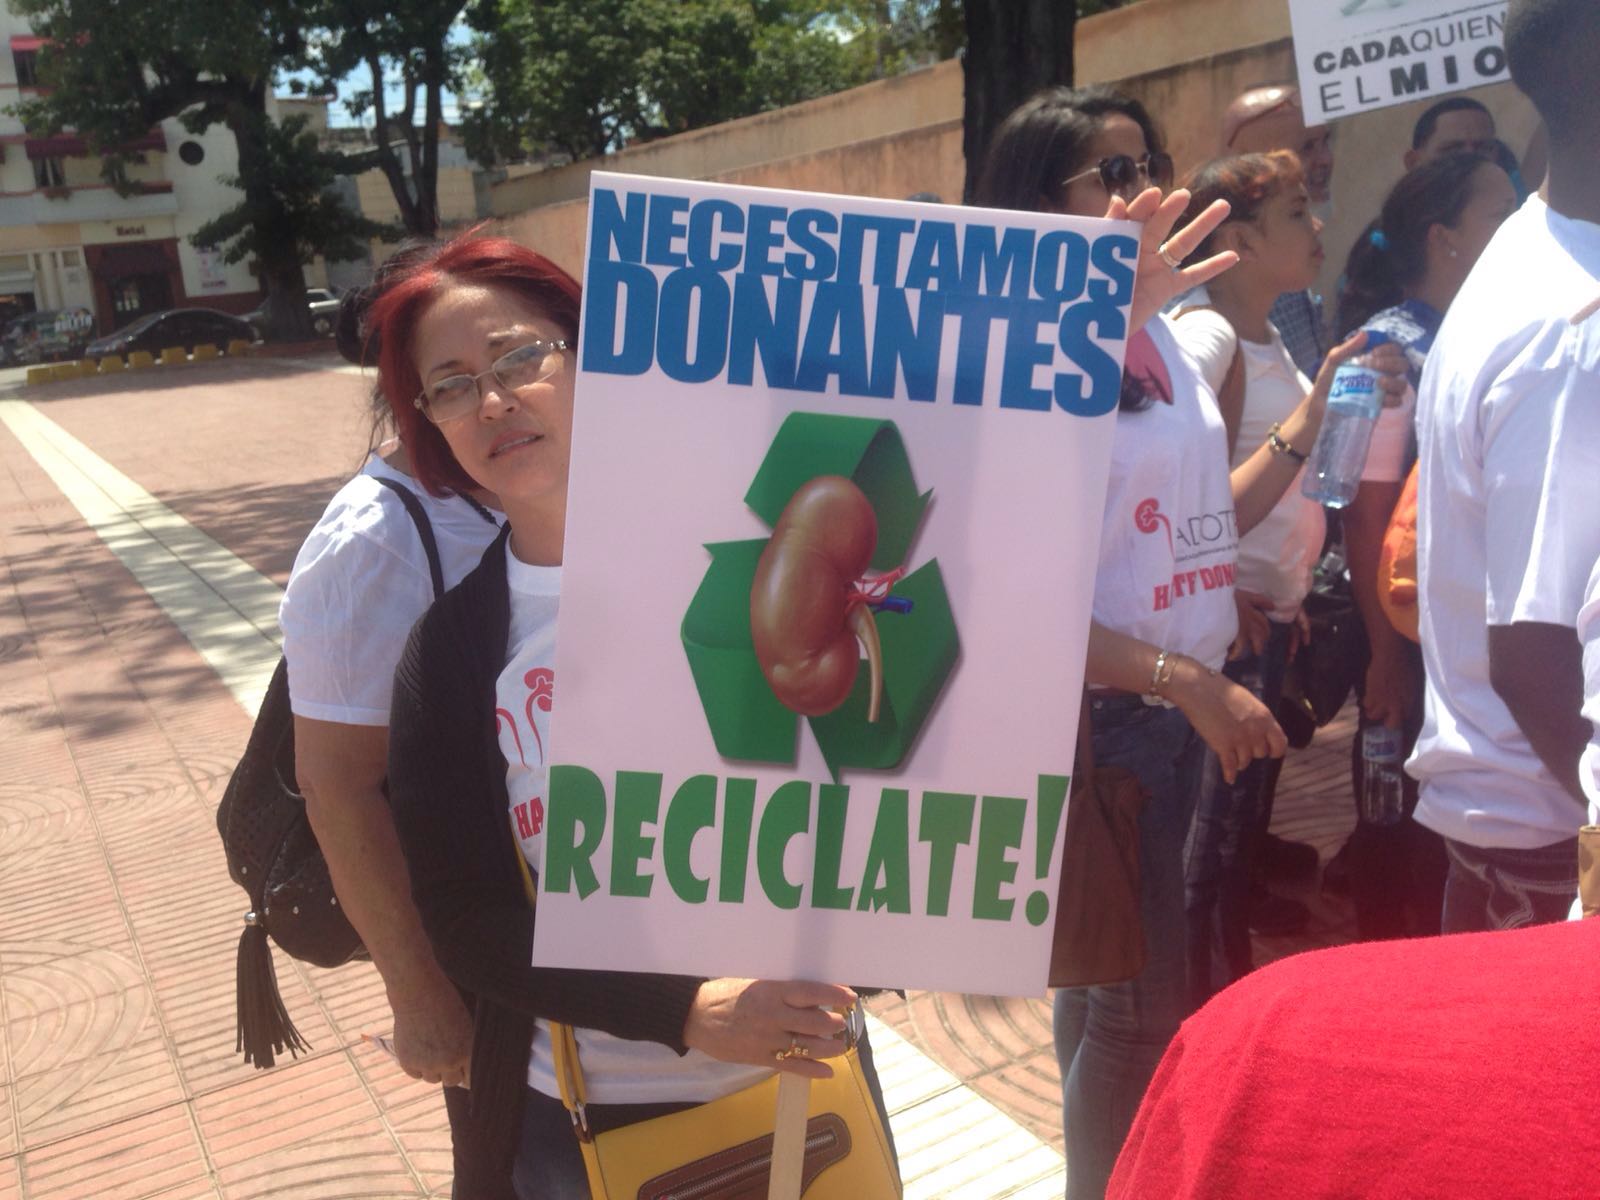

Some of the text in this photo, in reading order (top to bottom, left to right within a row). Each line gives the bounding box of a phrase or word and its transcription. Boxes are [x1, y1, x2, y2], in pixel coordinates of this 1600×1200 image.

[592, 188, 1140, 308] NECESITAMOS
[582, 258, 1127, 418] DONANTES
[544, 764, 1071, 928] RECICLATE!
